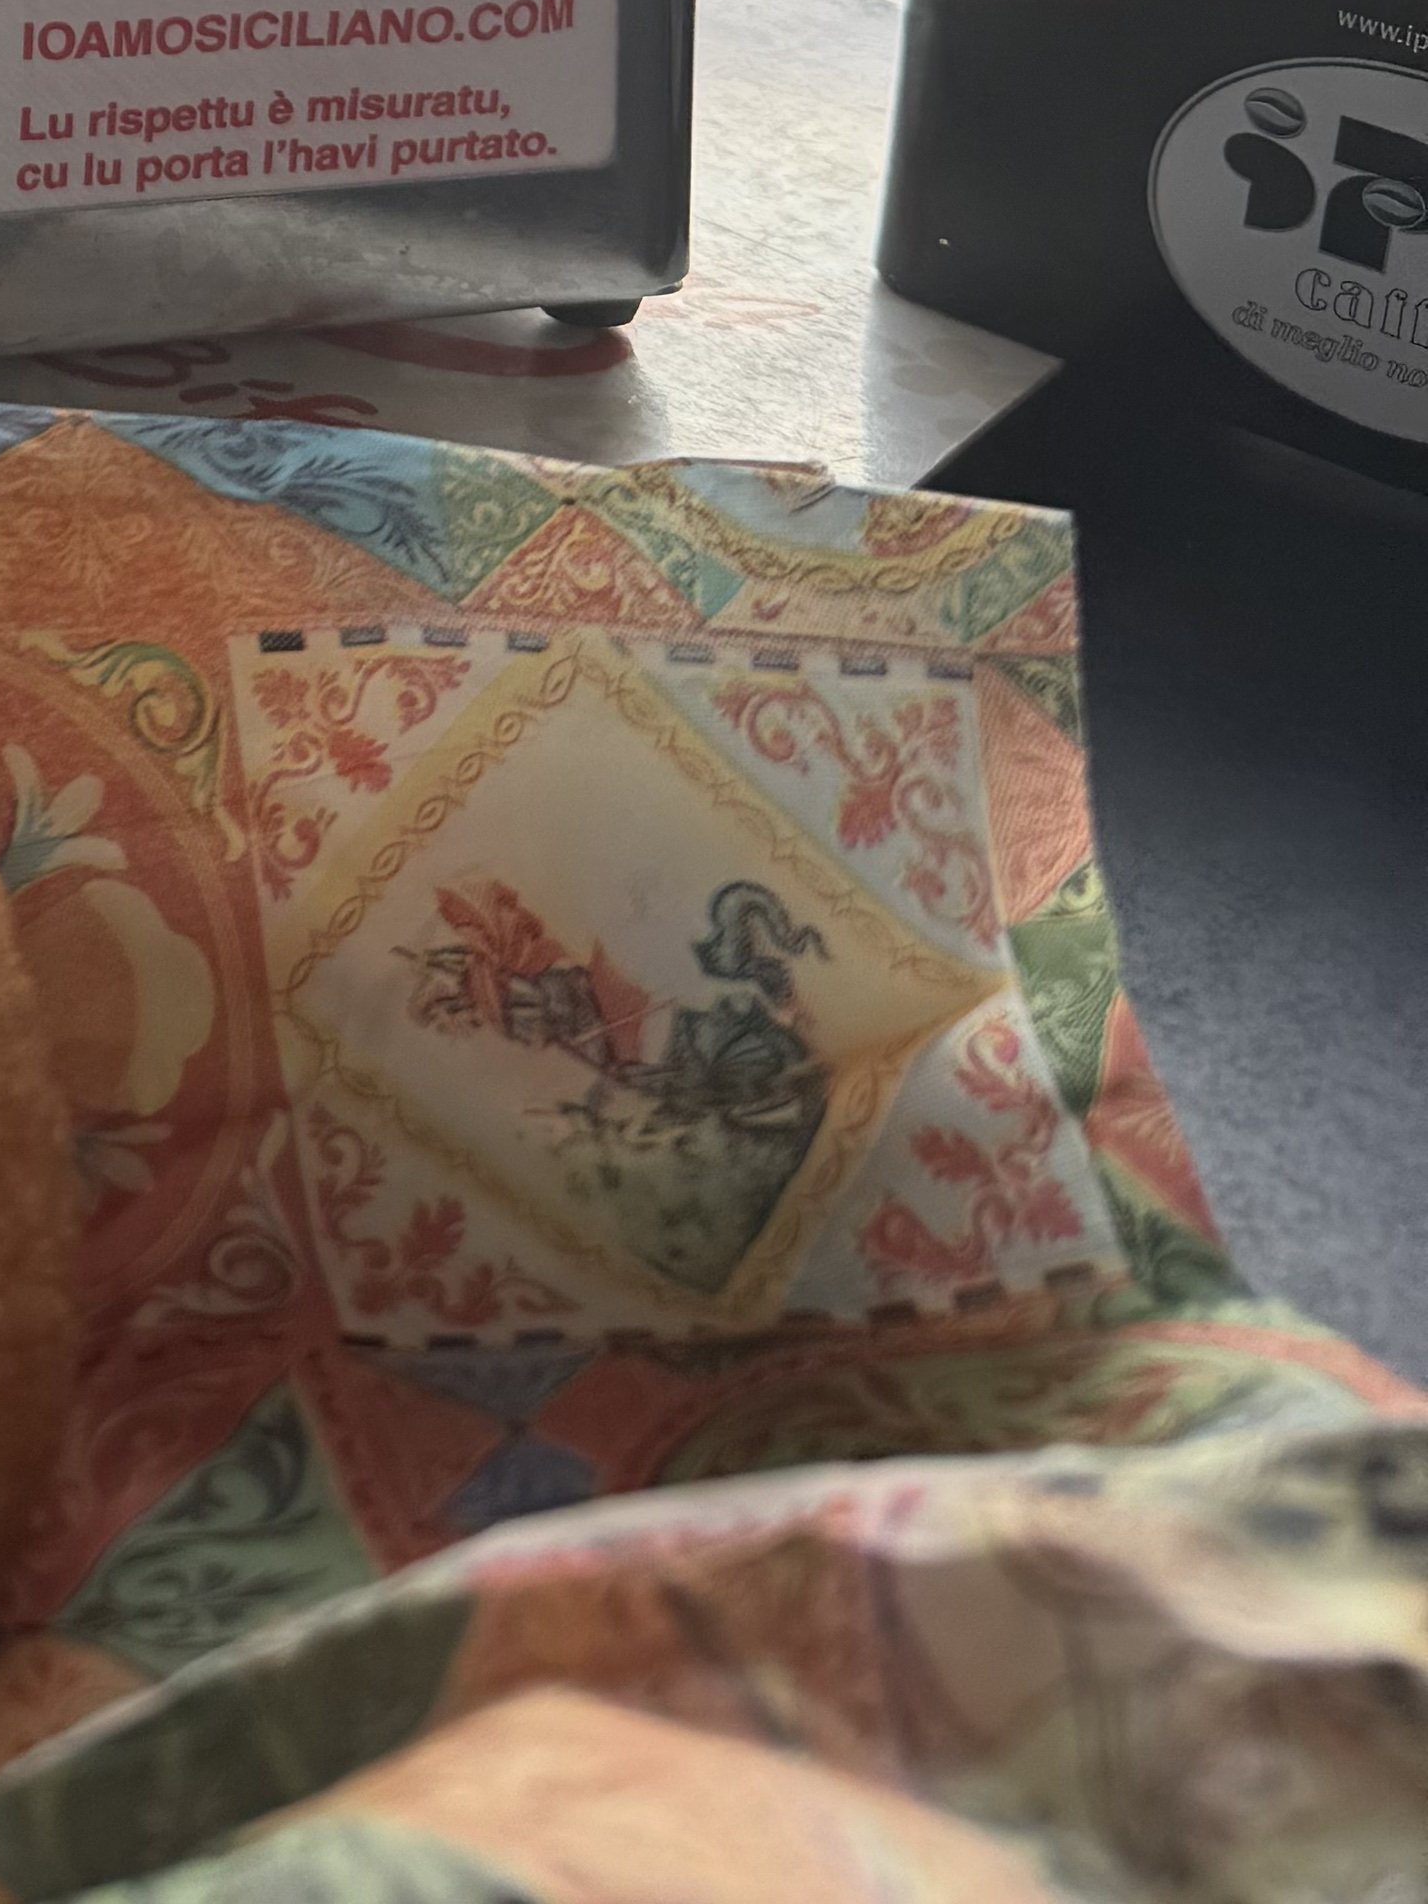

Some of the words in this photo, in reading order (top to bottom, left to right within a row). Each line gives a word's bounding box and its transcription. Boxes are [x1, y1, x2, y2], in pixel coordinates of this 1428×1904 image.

[20, 106, 73, 141] Lu
[88, 96, 255, 142] rispettu
[268, 90, 294, 125] è
[306, 85, 511, 123] misuratu,
[16, 162, 68, 191] cu
[83, 152, 122, 186] lu
[136, 146, 249, 192] porta
[391, 128, 557, 175] purtato.
[1231, 300, 1267, 332] di
[1270, 315, 1380, 373] meglio
